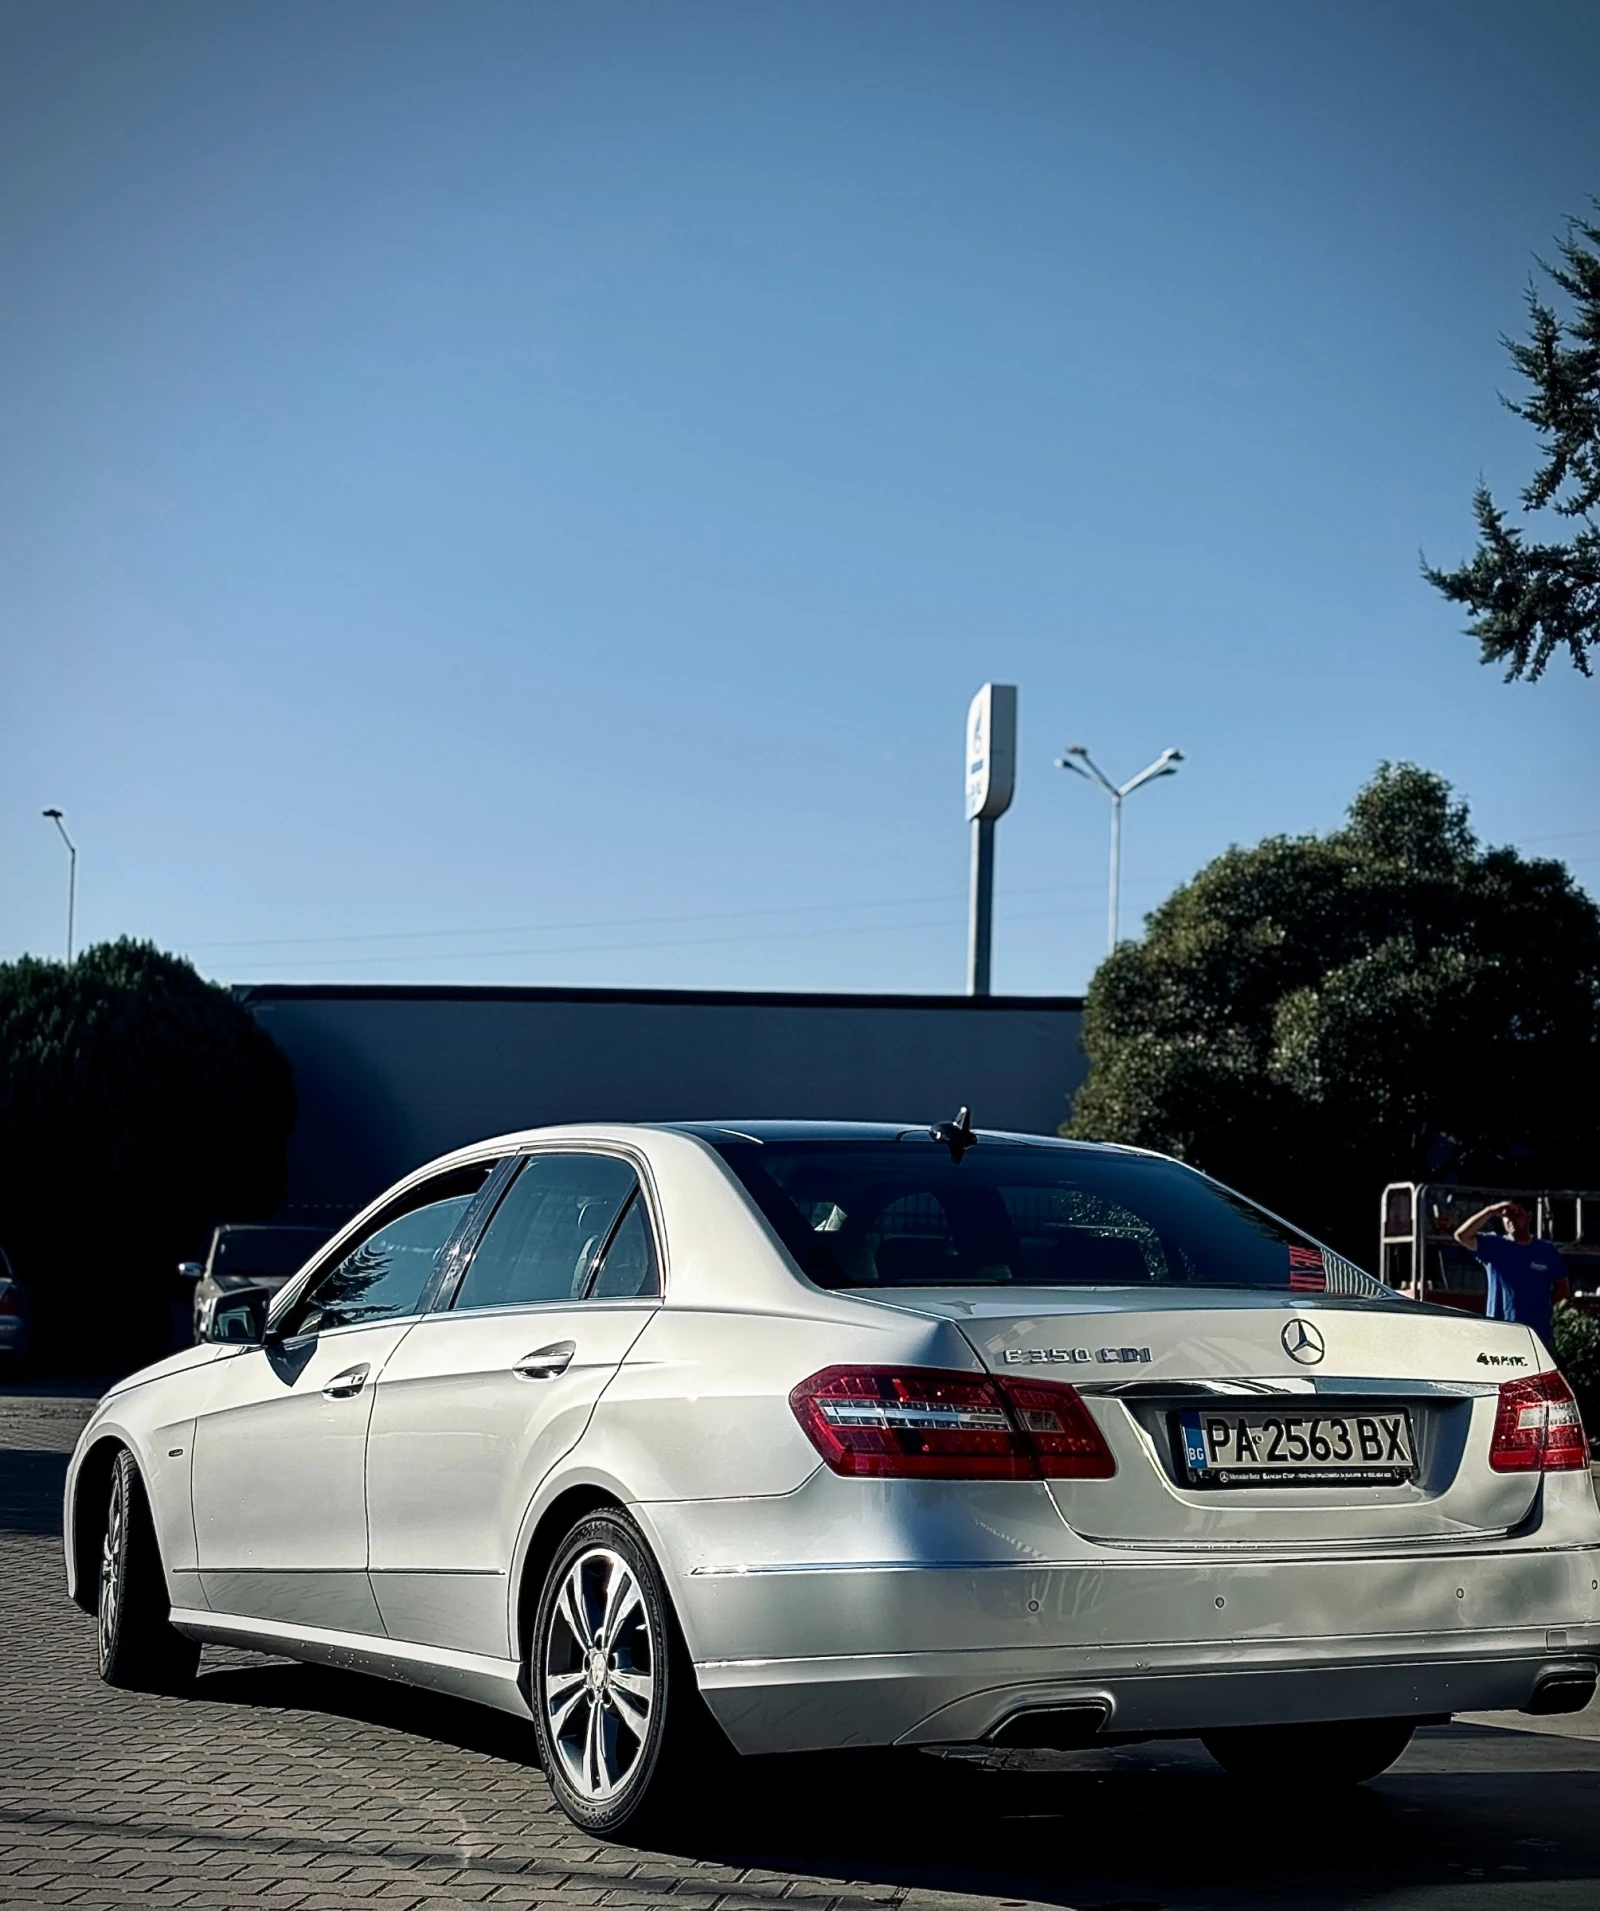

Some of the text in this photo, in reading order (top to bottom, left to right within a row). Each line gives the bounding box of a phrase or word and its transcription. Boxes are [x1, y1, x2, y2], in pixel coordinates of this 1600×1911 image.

[1003, 1347, 1153, 1364] E 350 CDI
[1206, 1418, 1410, 1463] PA 2563 BX
[1188, 1447, 1205, 1461] BG
